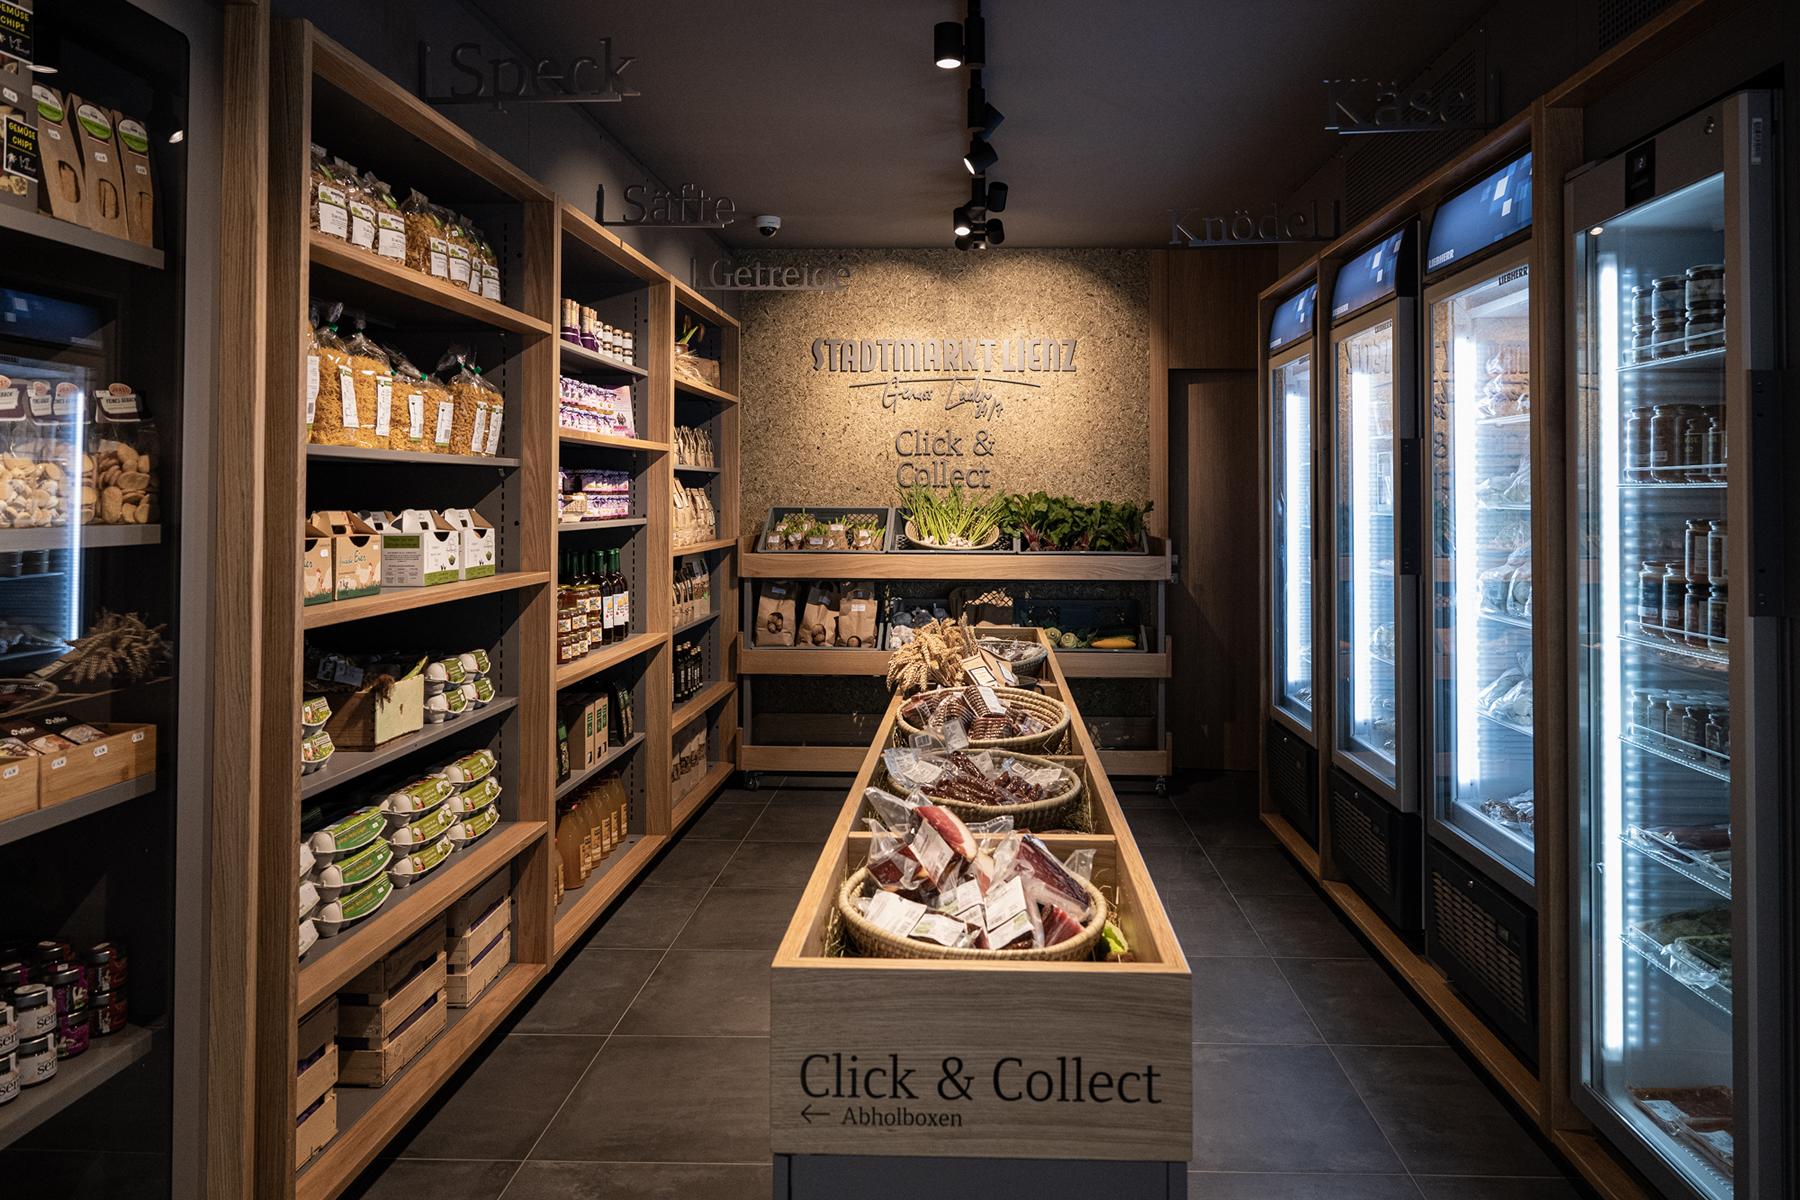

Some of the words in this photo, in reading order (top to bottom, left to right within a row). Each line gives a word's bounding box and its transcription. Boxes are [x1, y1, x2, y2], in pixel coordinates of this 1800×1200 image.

[0, 15, 25, 32] CHIPS
[450, 37, 641, 114] Speck
[1322, 79, 1473, 130] Käse
[12, 136, 33, 151] CHIPS
[623, 179, 737, 226] Säfte
[1168, 199, 1320, 245] Knödel
[708, 257, 852, 290] Getreide
[1428, 249, 1455, 269] LIEBHERR
[1498, 265, 1529, 287] LIEBHERR
[811, 338, 996, 373] STADTMARKT
[1000, 338, 1077, 373] LIENZ
[895, 429, 964, 457] Click
[973, 429, 995, 457] &
[896, 459, 992, 489] Collect
[800, 1053, 919, 1100] Click
[937, 1056, 975, 1102] &
[993, 1056, 1163, 1104] Collect
[841, 1106, 963, 1128] Abholboxen
